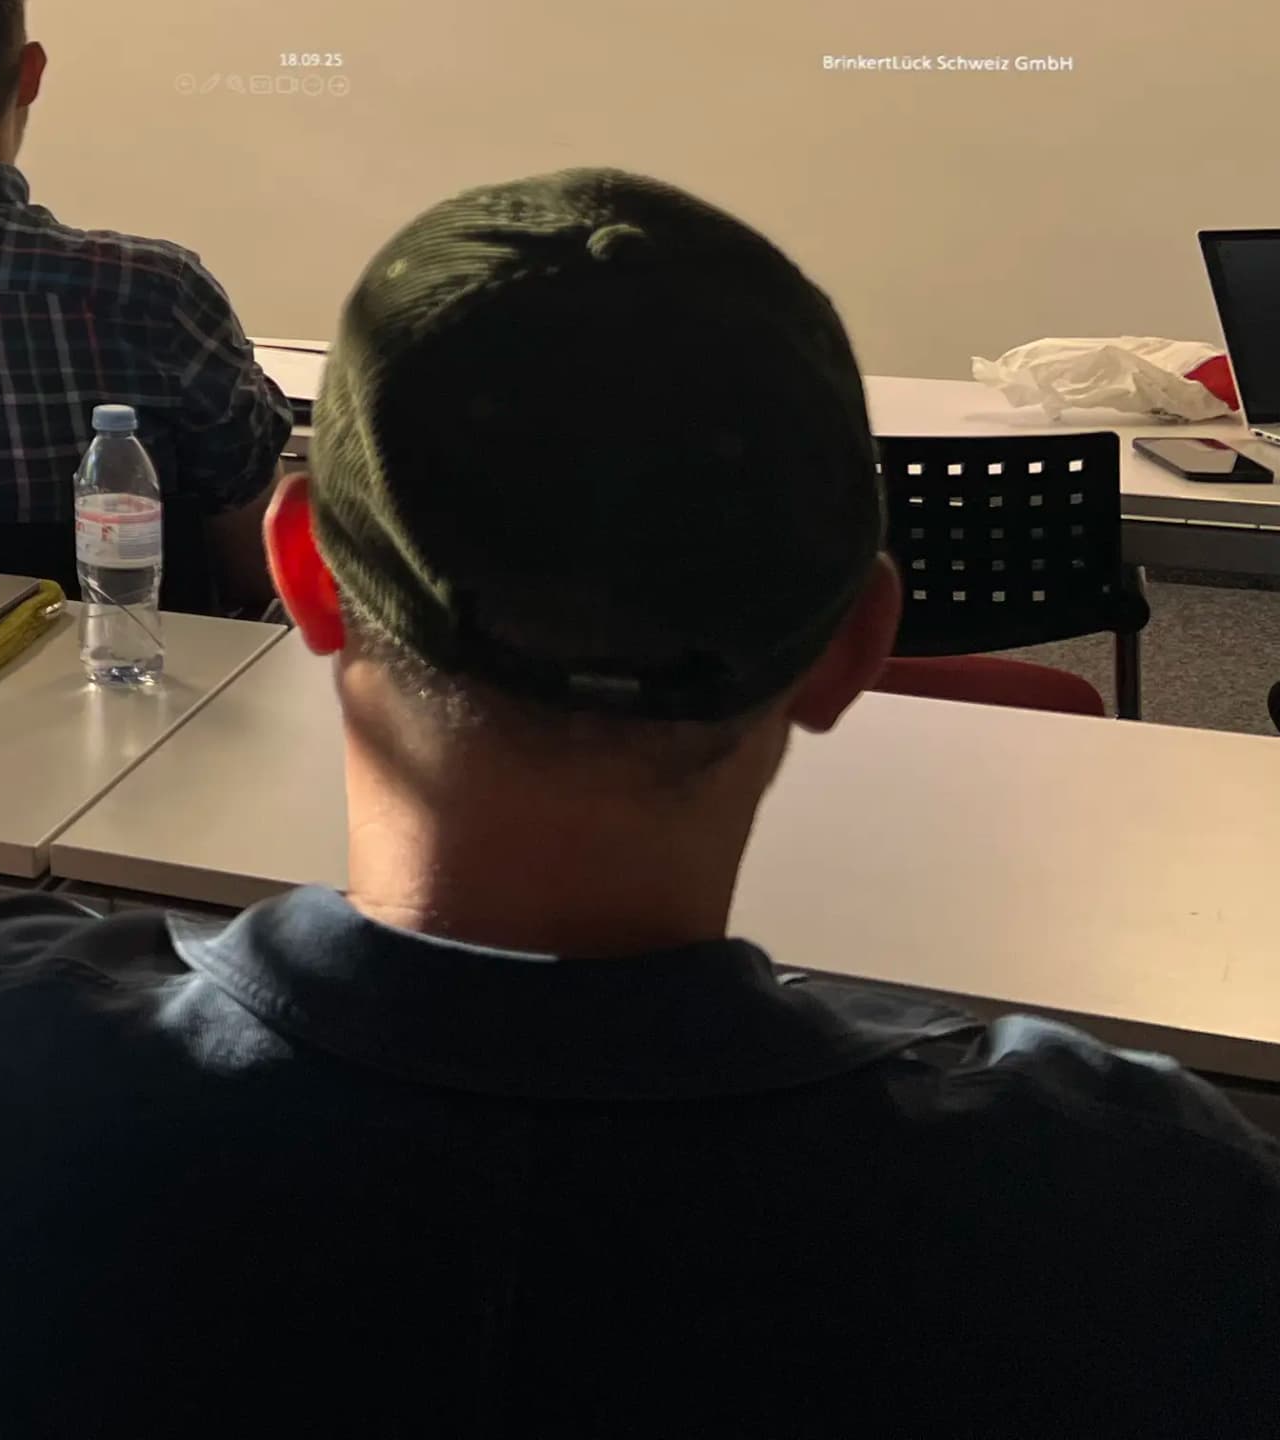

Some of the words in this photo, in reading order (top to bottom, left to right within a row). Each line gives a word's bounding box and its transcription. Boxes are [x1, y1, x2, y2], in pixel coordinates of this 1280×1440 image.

[279, 53, 343, 67] 18.09.25
[823, 55, 932, 71] BrinkertLück
[937, 56, 1009, 71] Schweiz
[1015, 56, 1074, 71] GmbH
